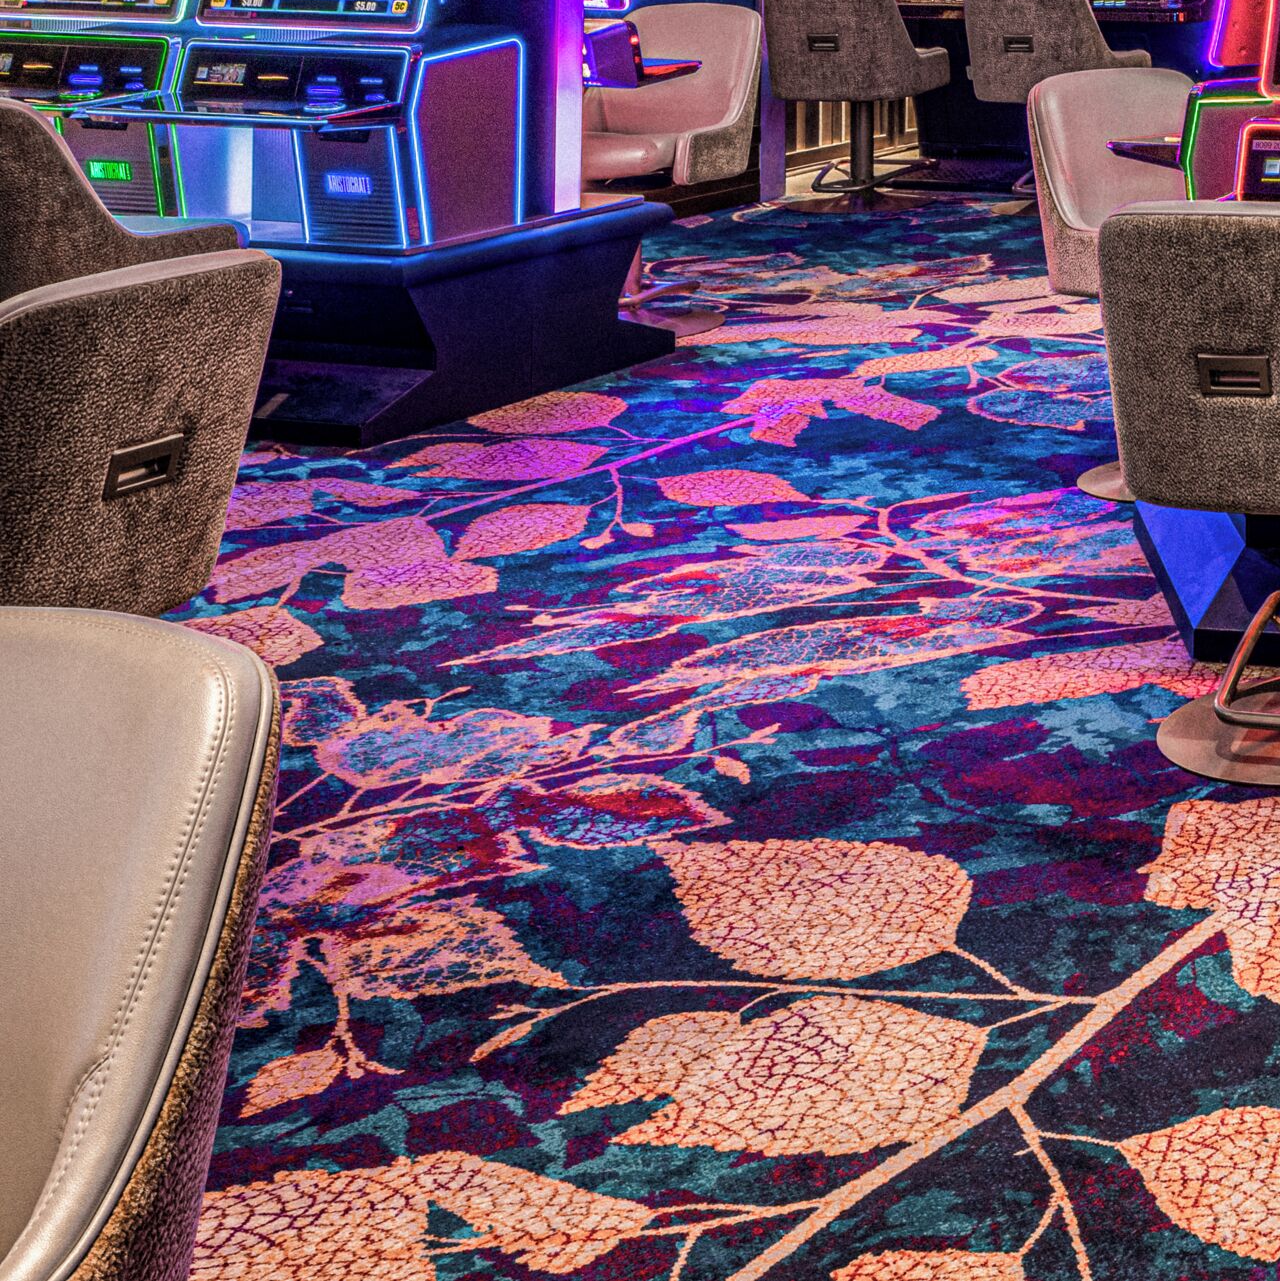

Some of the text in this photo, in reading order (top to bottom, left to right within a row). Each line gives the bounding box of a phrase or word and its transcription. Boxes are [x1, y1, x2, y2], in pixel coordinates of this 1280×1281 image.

[355, 1, 376, 11] $5.00
[395, 1, 406, 11] 5¢
[90, 162, 127, 180] ARISTOCRAT
[328, 175, 367, 193] ARISTOCRAT
